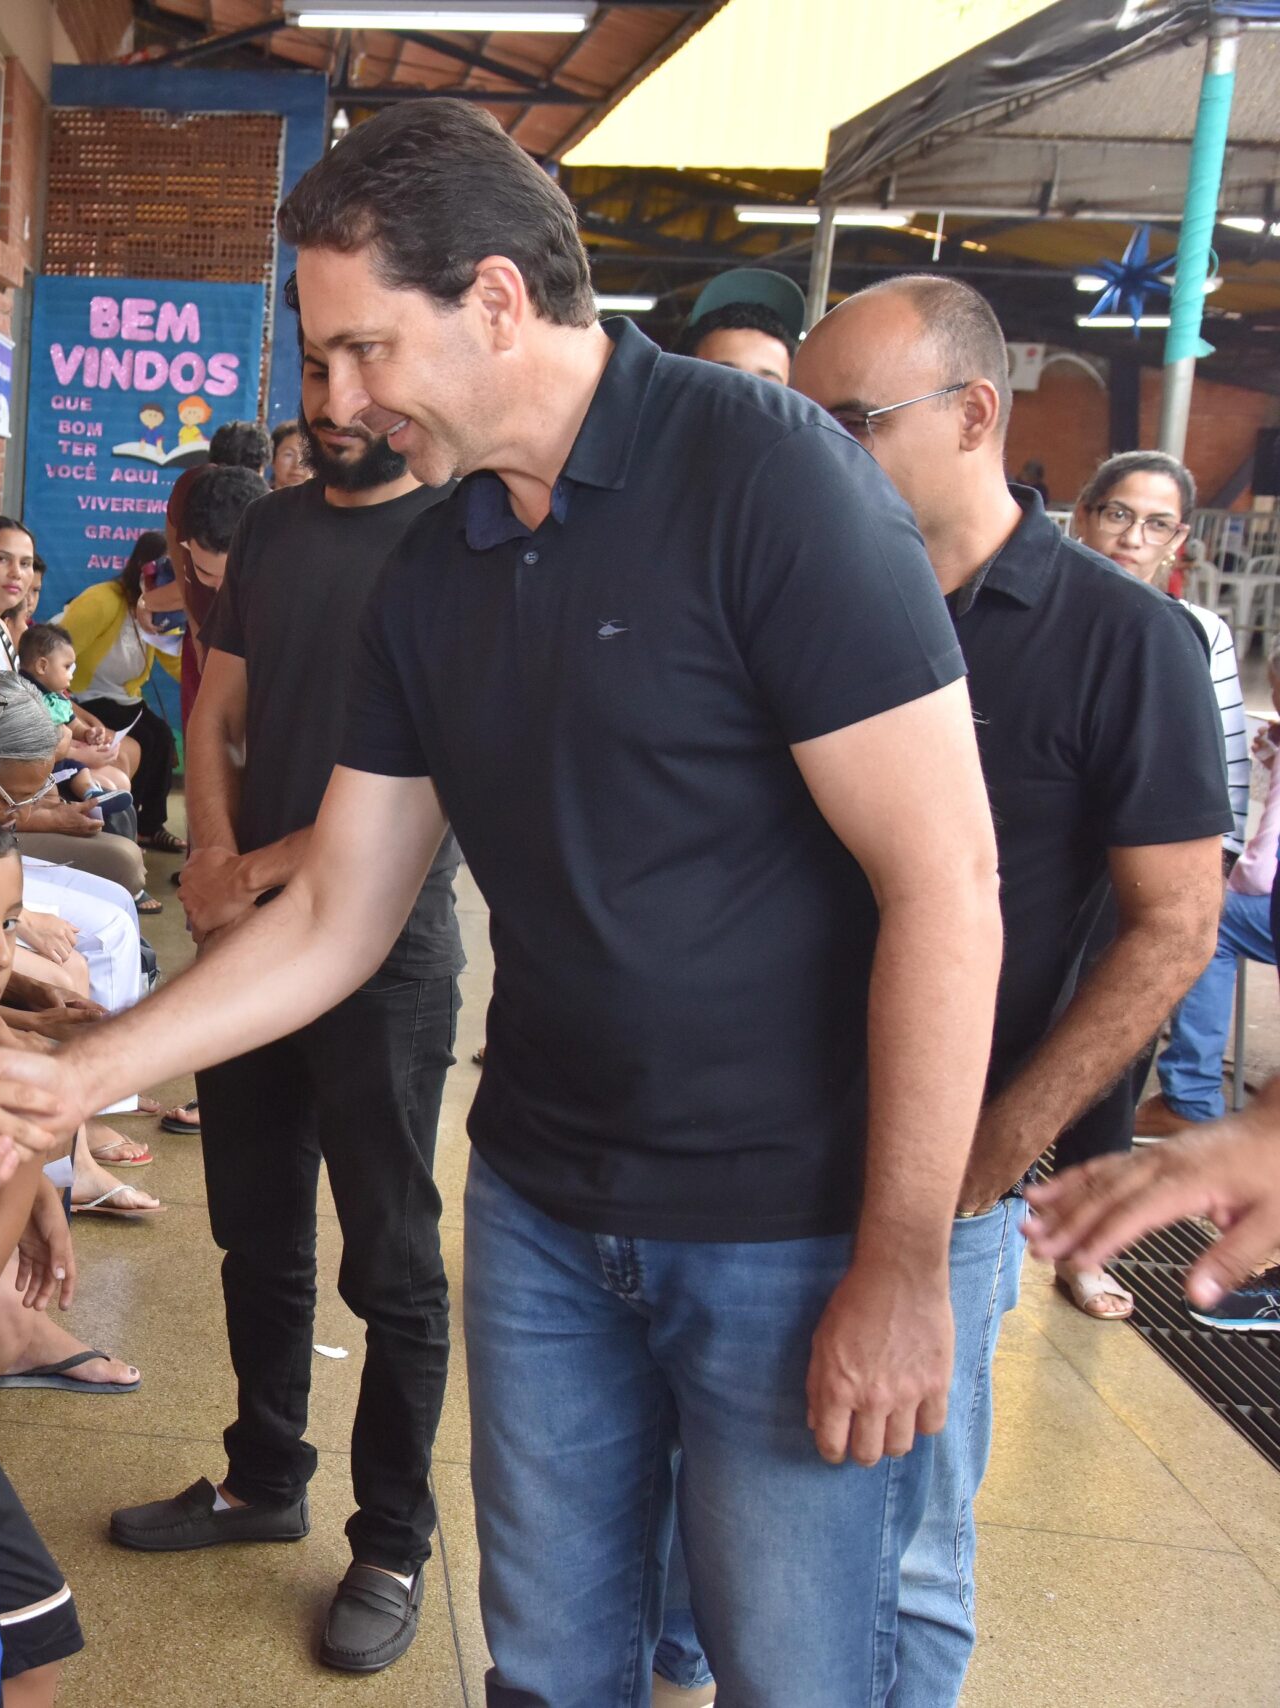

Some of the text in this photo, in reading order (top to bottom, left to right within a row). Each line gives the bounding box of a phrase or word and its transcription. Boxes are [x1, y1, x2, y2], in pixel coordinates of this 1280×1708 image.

[90, 296, 200, 343] BEM
[50, 343, 239, 396] VINDOS
[51, 395, 92, 411] QUE
[58, 419, 103, 437] BOM
[58, 440, 97, 457] TER
[45, 461, 97, 481] VOCÊ
[85, 525, 163, 541] GRAN
